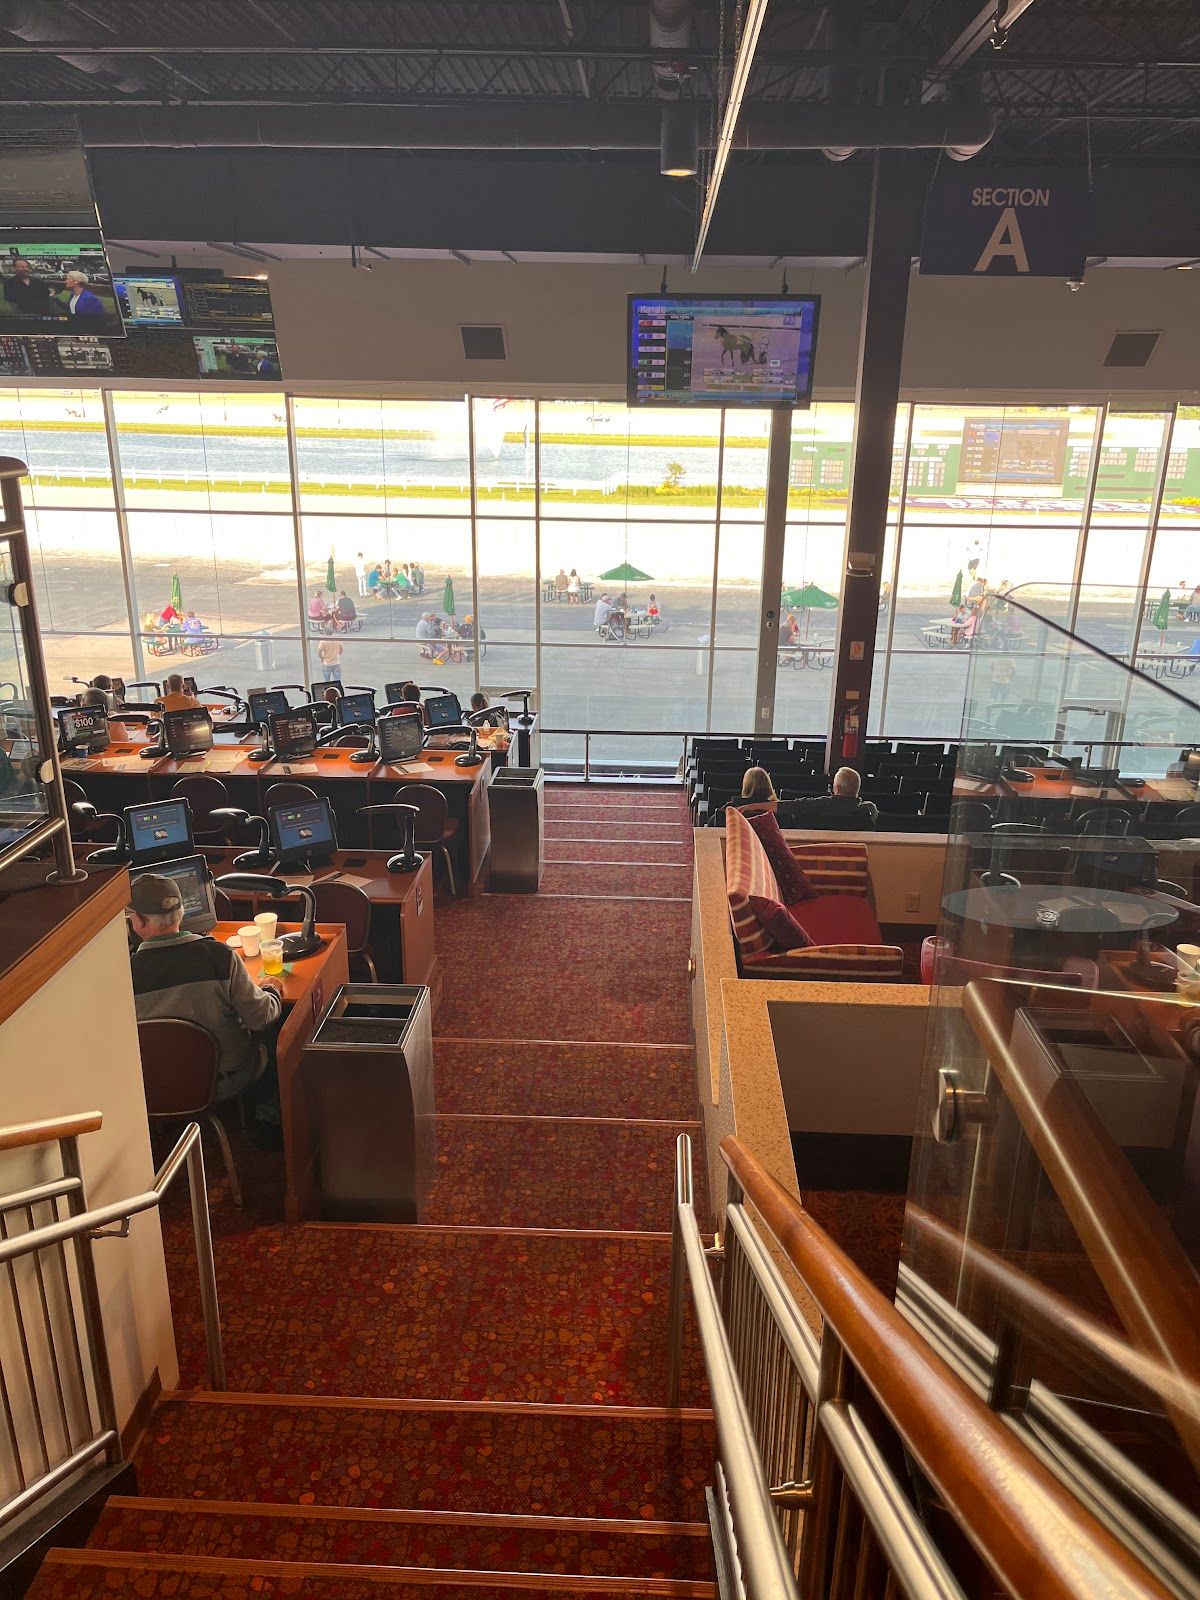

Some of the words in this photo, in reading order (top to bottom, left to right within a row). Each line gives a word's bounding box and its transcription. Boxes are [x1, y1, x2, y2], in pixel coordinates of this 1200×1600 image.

[972, 187, 1050, 207] SECTION
[973, 207, 1031, 272] A
[75, 717, 94, 728] $100
